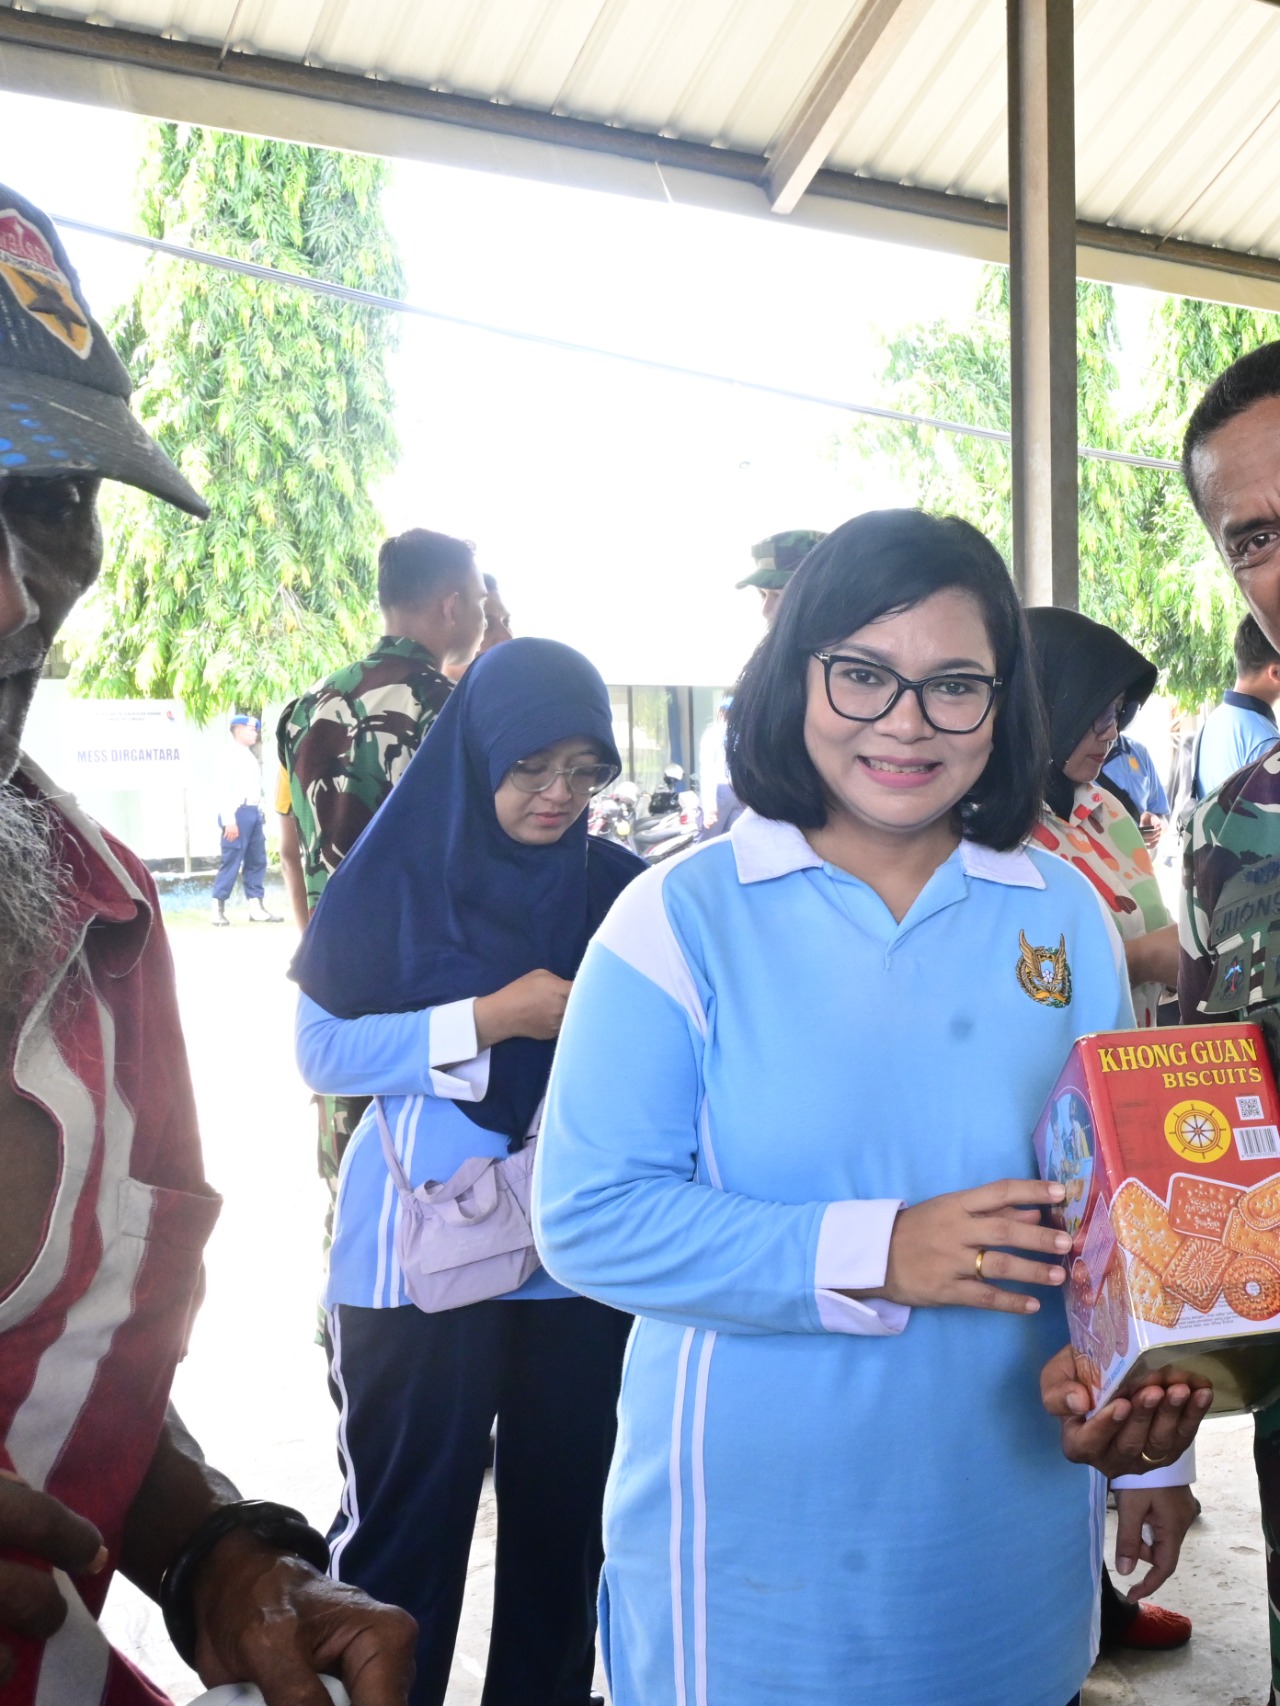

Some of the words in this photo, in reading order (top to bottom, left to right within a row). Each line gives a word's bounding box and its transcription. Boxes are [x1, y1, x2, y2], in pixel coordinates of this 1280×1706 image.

[77, 749, 108, 763] MESS
[111, 748, 181, 762] DIRGANTARA
[1097, 1041, 1188, 1074] KHONG
[1191, 1038, 1258, 1065] GUAN
[1163, 1066, 1263, 1089] BISCUITS
